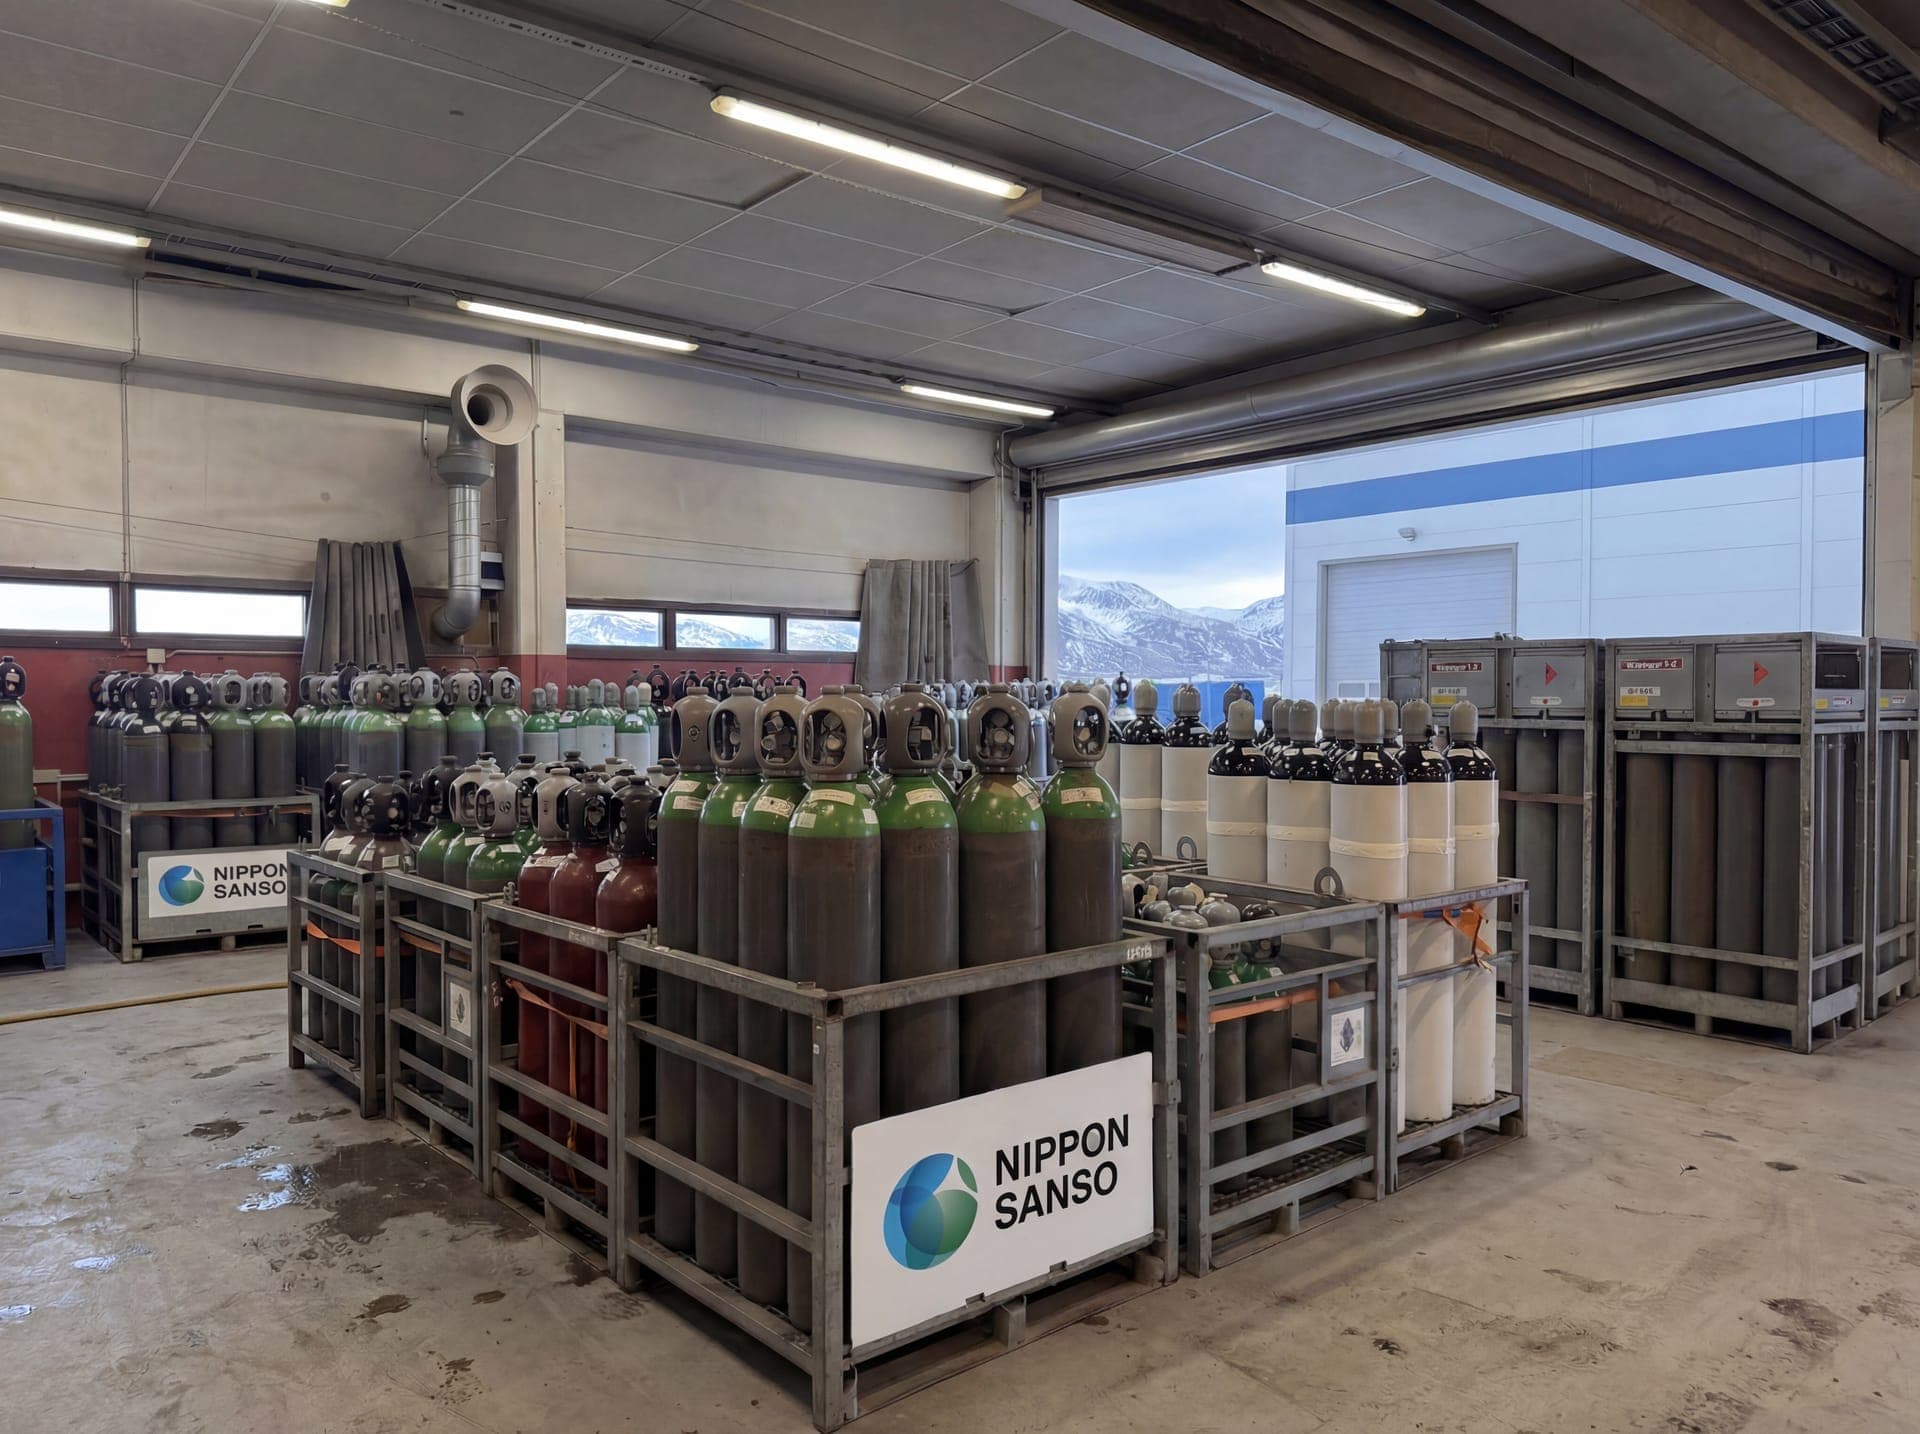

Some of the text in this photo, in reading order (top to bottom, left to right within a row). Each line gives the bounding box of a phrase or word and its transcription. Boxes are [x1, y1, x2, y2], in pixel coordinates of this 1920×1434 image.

[214, 863, 288, 881] NIPPON
[214, 880, 286, 899] SANSO
[996, 1114, 1129, 1186] NIPPON
[995, 1161, 1118, 1230] SANSO
